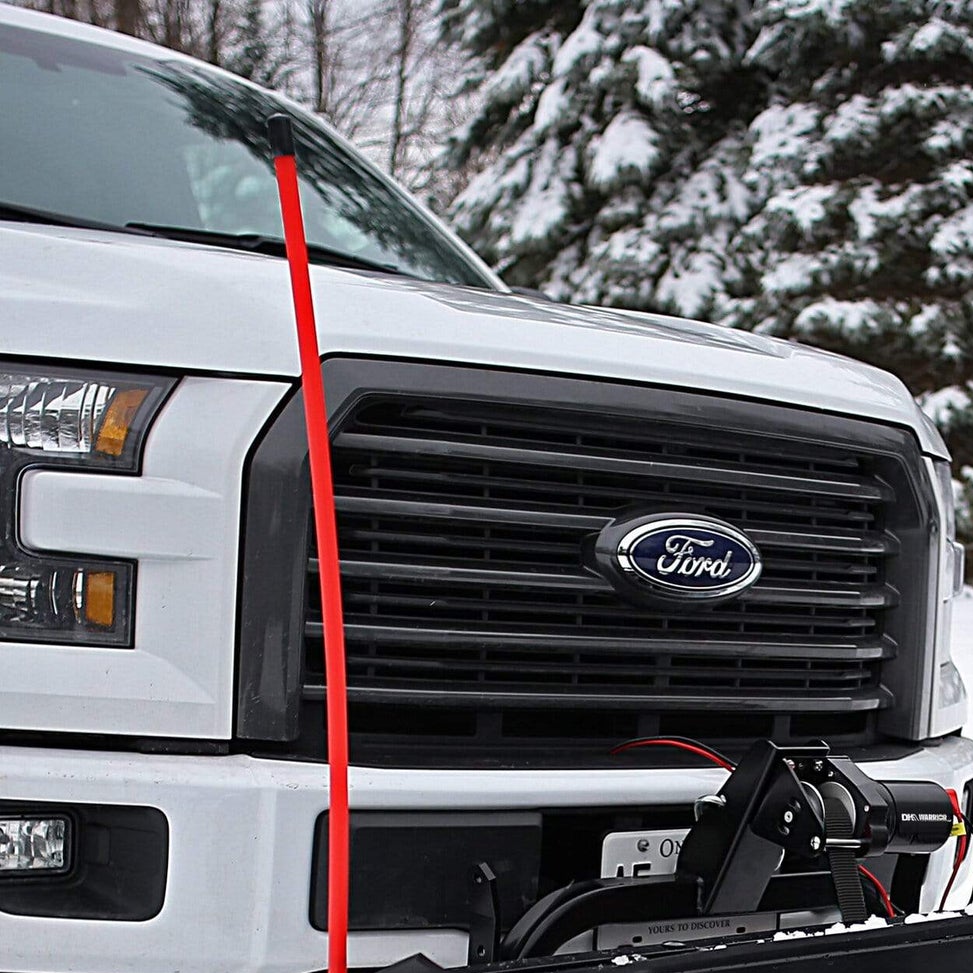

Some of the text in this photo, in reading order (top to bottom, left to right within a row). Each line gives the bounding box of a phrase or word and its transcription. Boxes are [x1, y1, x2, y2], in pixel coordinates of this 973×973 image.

[657, 534, 732, 578] Ford
[648, 919, 730, 935] YOURS TO DISCOVER
